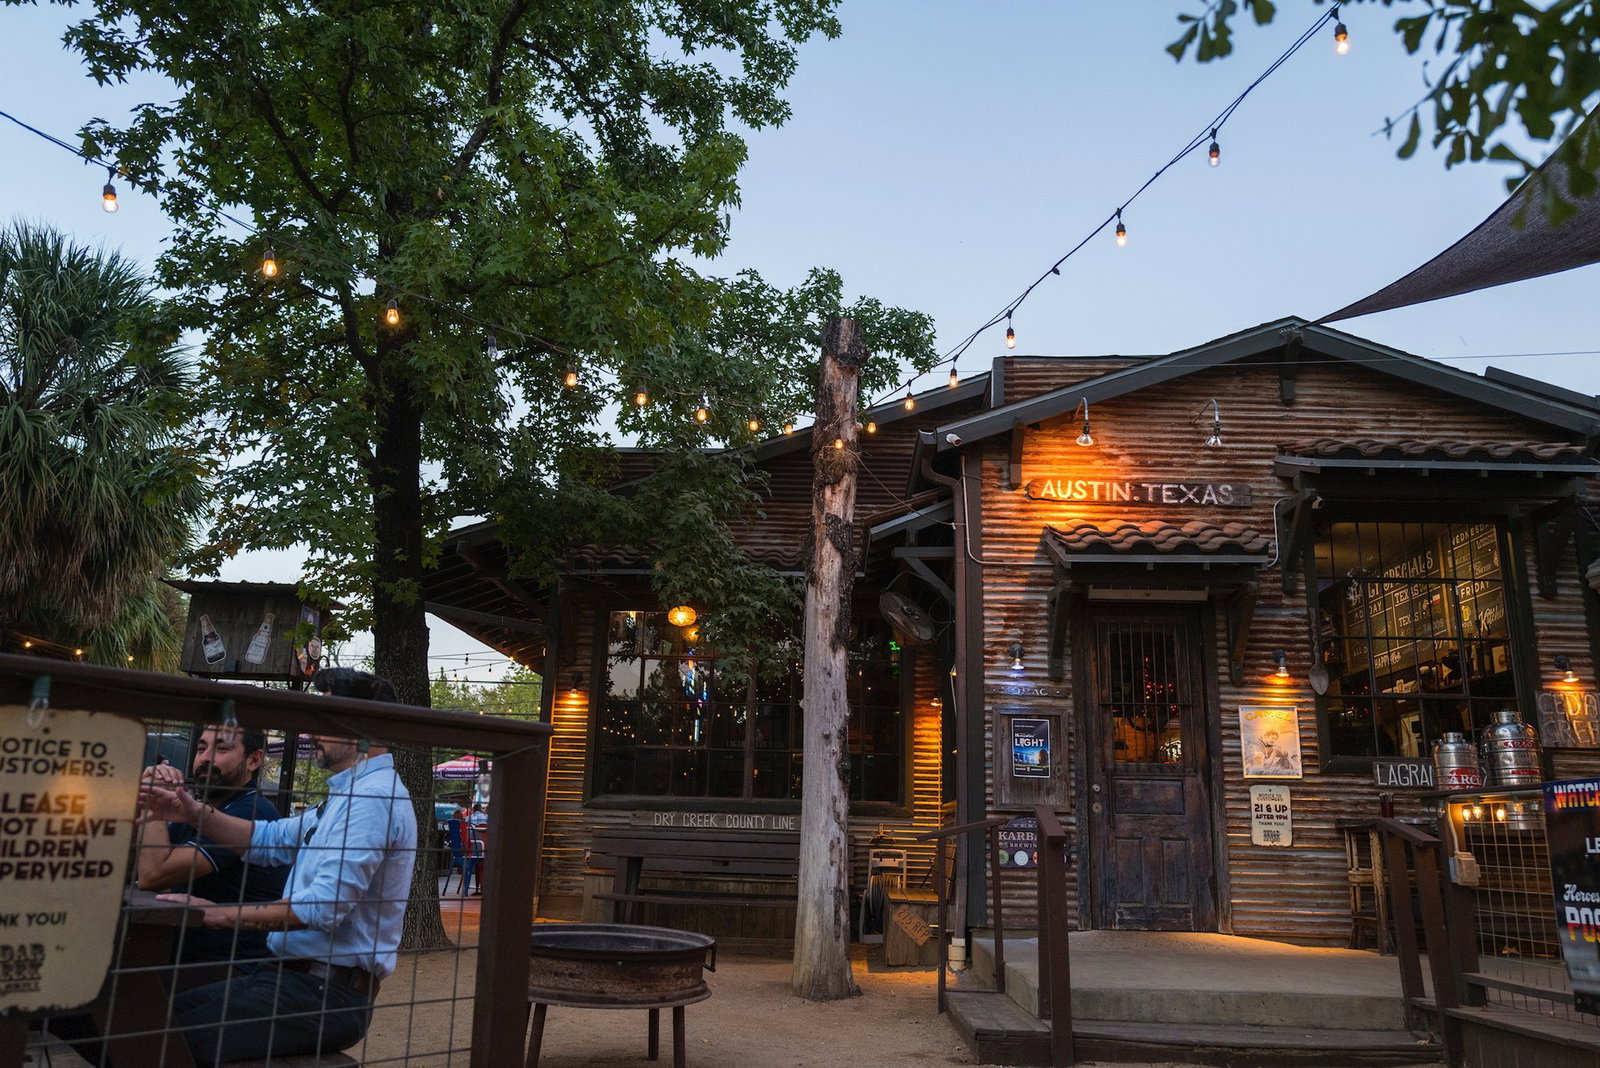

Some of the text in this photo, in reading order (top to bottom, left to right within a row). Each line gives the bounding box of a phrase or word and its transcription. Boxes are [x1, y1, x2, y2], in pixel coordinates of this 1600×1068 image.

[1141, 483, 1235, 505] TEXAS
[1460, 581, 1490, 599] FRIDAY
[1353, 601, 1382, 621] MODAY
[1539, 692, 1600, 715] CEDA
[0, 738, 107, 758] OTICE TO
[1015, 738, 1044, 747] LIGHT
[1376, 764, 1433, 787] LAGRA
[0, 793, 86, 813] LEASE
[1254, 803, 1288, 813] 21 & UP
[0, 817, 117, 838] OT LEAVE
[654, 812, 795, 830] DRY CREEK COUNTY LINE
[0, 839, 87, 858] ILDREN
[26, 911, 67, 927] YOU!
